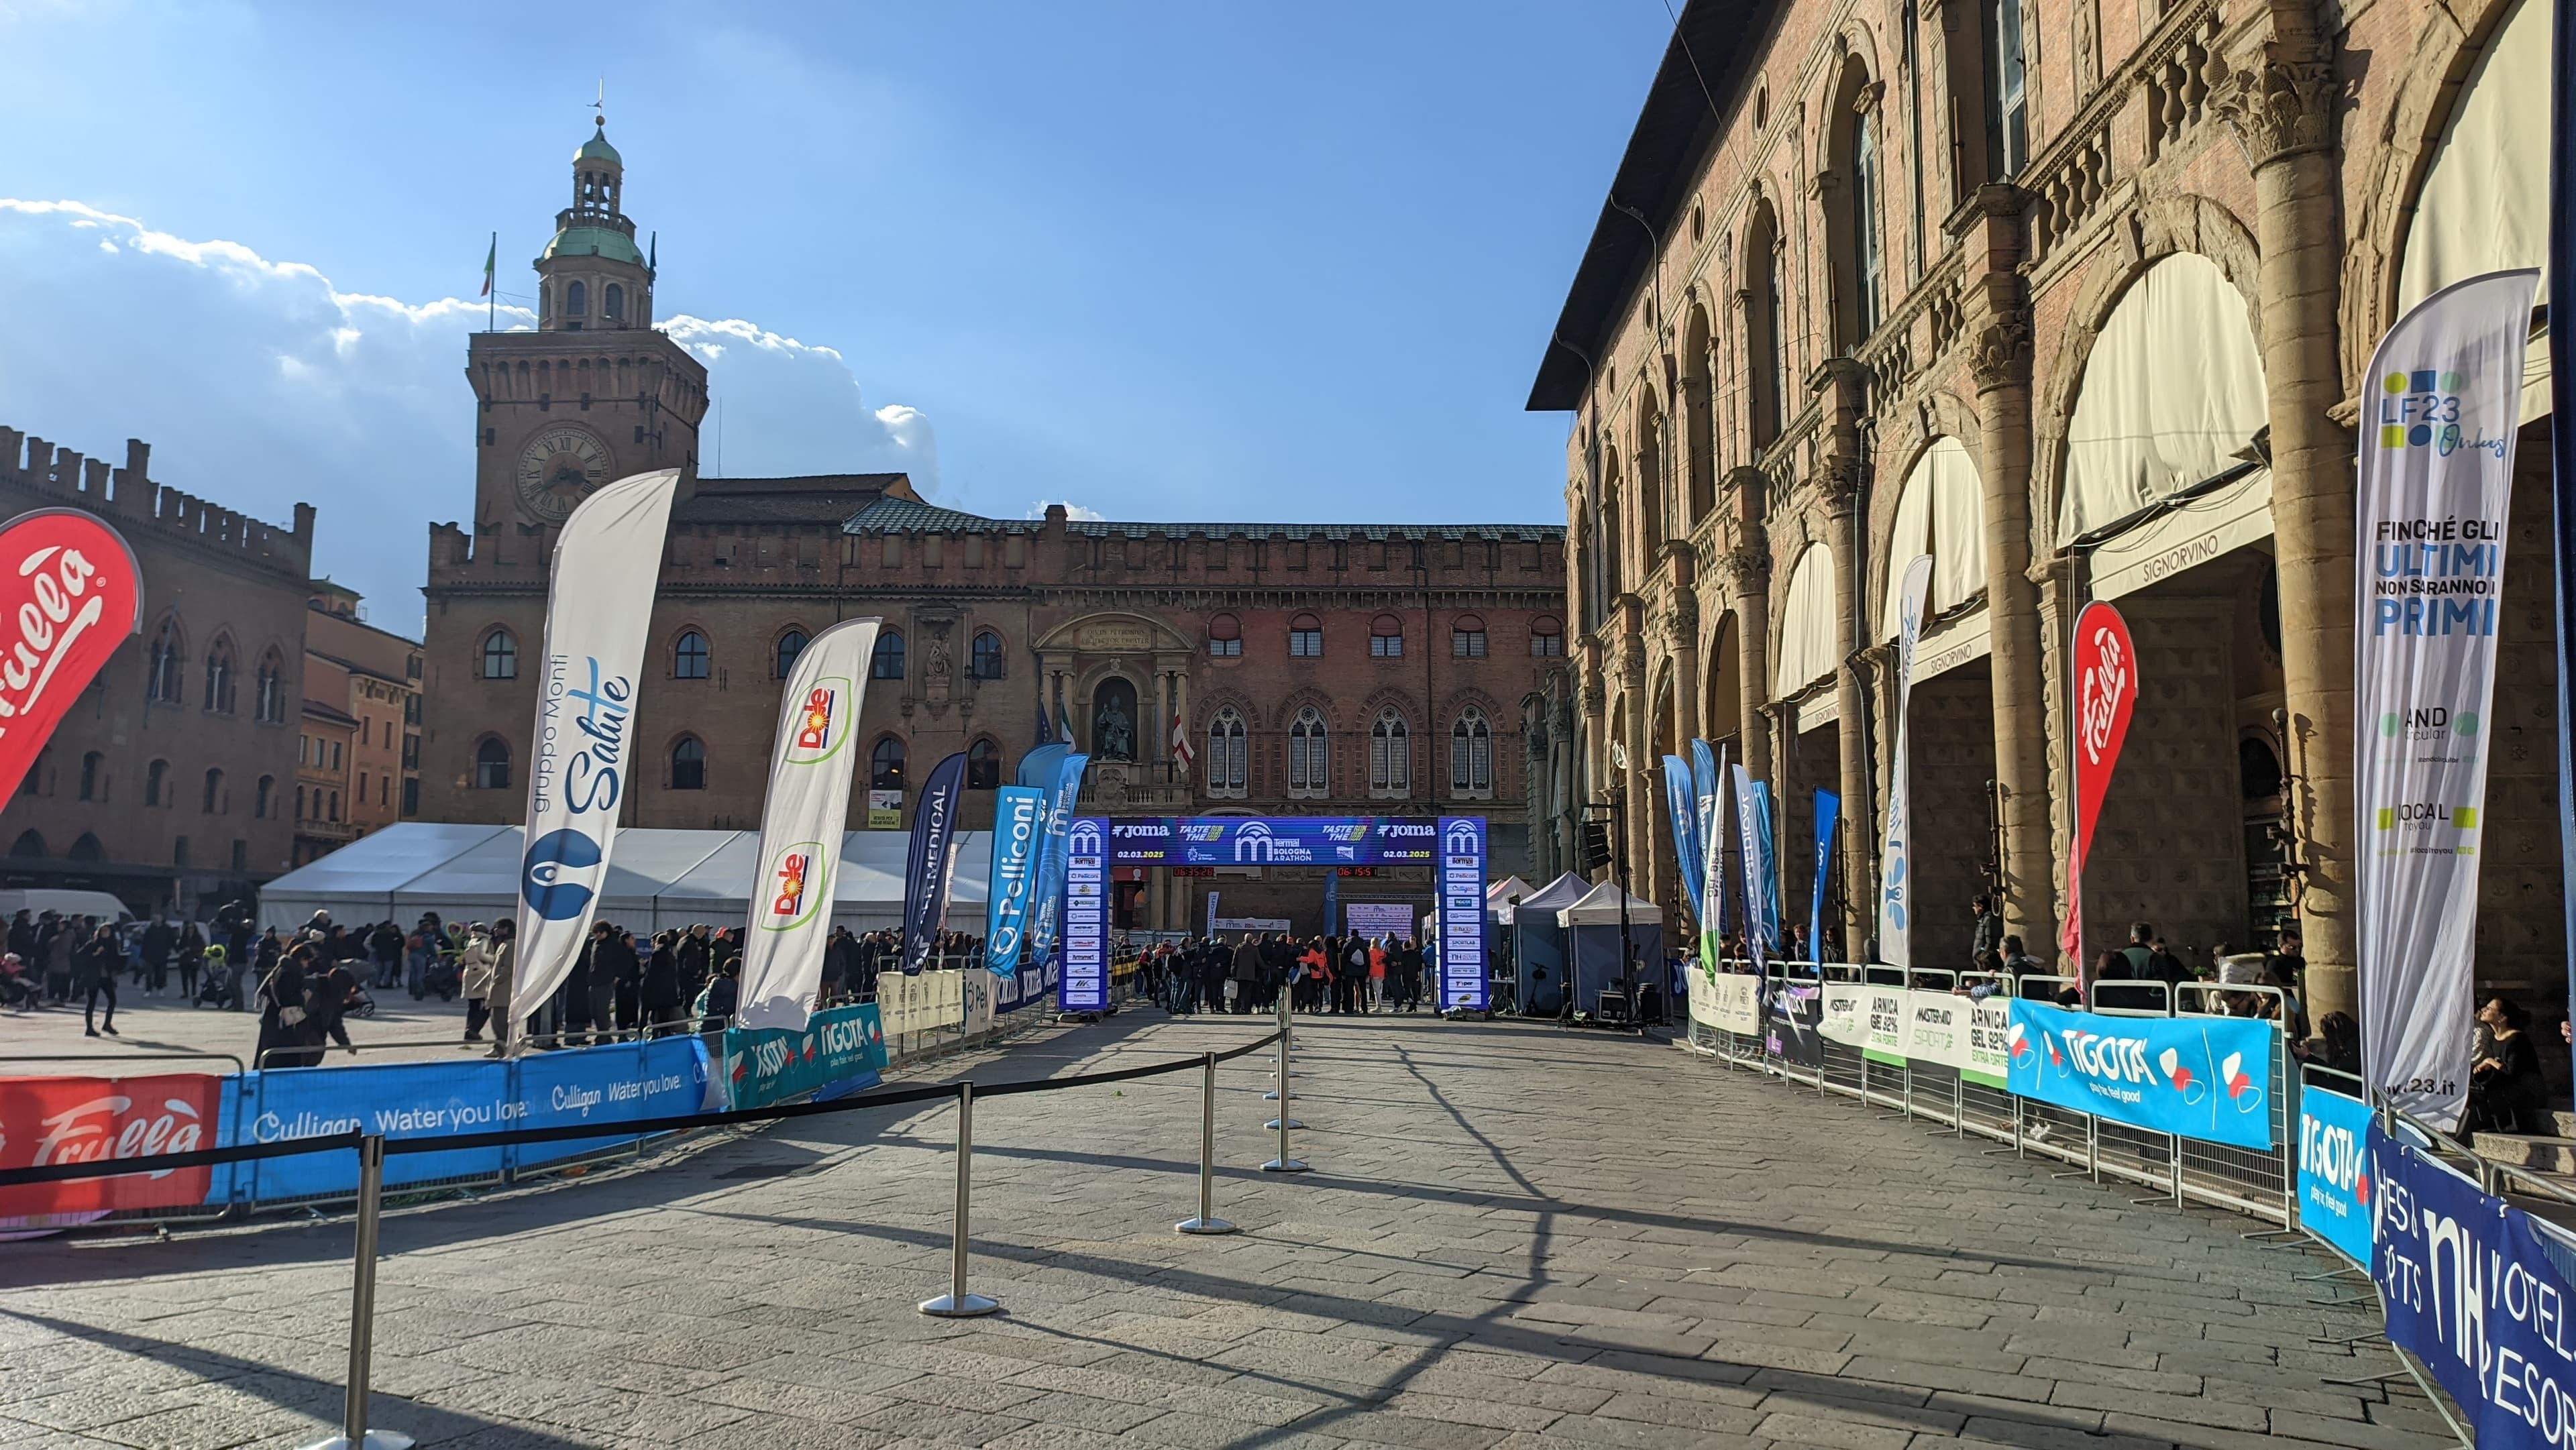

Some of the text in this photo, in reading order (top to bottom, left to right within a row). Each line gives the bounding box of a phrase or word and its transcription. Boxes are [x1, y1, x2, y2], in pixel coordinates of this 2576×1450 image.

[2381, 394, 2460, 423] LF23
[2377, 516, 2498, 541] FINCHÉ GLI
[2143, 535, 2218, 582] SIGNORVINO
[2375, 543, 2497, 577] ULTIMI
[2375, 582, 2407, 595] NON
[2410, 579, 2486, 596] SARANNO
[2375, 598, 2493, 636] PRIMI
[1931, 644, 1972, 673] SIGNORVINO
[798, 687, 829, 749] Dole
[2405, 708, 2447, 728] AND
[534, 654, 569, 814] gruppo Monti
[565, 656, 631, 815] Salute
[926, 785, 947, 880] MEDICAL
[1275, 838, 1299, 847] Termal
[999, 797, 1034, 915] Pelliconi
[774, 853, 804, 915] Dole
[1175, 868, 1213, 876] 06:35:28
[1871, 997, 1898, 1016] ARNICA
[1971, 1008, 2008, 1031] ARNICA
[1971, 1029, 1986, 1048] GEL
[1972, 1050, 1990, 1066] EXTRA
[552, 1084, 601, 1118] Culligan
[608, 1081, 641, 1102] Water
[642, 1079, 661, 1101] you
[2121, 1089, 2141, 1104] good
[254, 1110, 361, 1144] Culligan
[376, 1108, 445, 1132] Water
[449, 1106, 491, 1132] you
[2335, 1199, 2347, 1218] good
